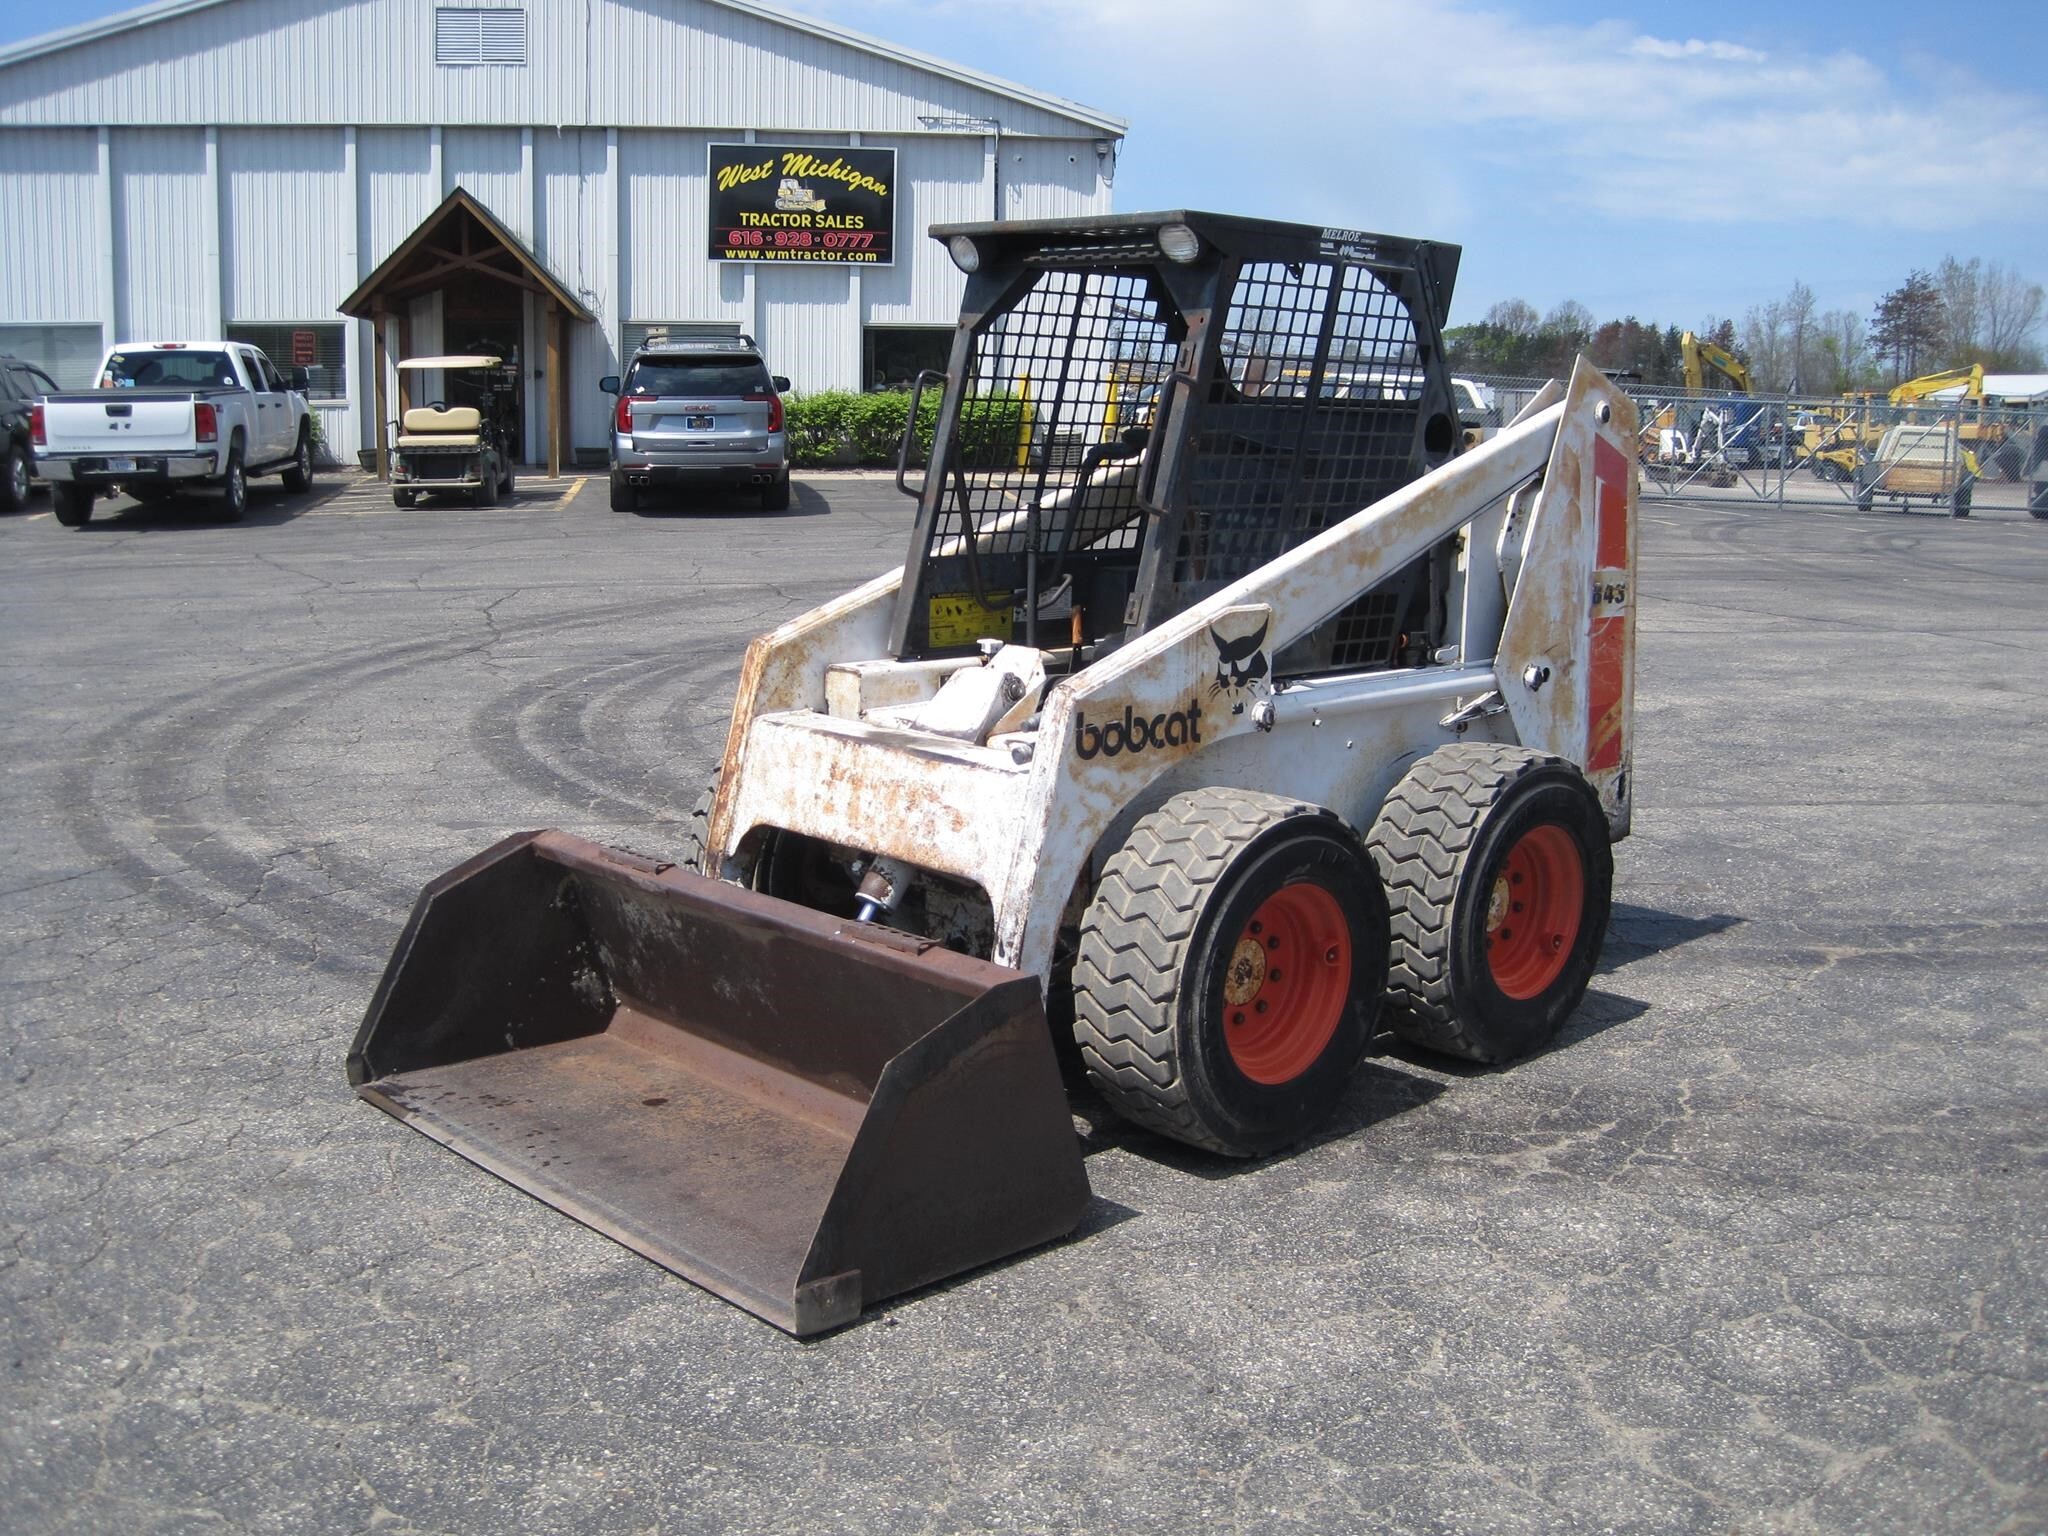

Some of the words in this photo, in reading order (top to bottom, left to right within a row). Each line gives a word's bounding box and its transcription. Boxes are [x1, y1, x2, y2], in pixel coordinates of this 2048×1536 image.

[717, 159, 774, 192] West
[782, 152, 888, 196] Michigan
[740, 212, 812, 228] TRACTOR
[815, 214, 864, 229] SALES
[1321, 228, 1361, 242] MELROE
[725, 249, 878, 262] www.wmtractor.com
[1075, 698, 1202, 760] bobcat
